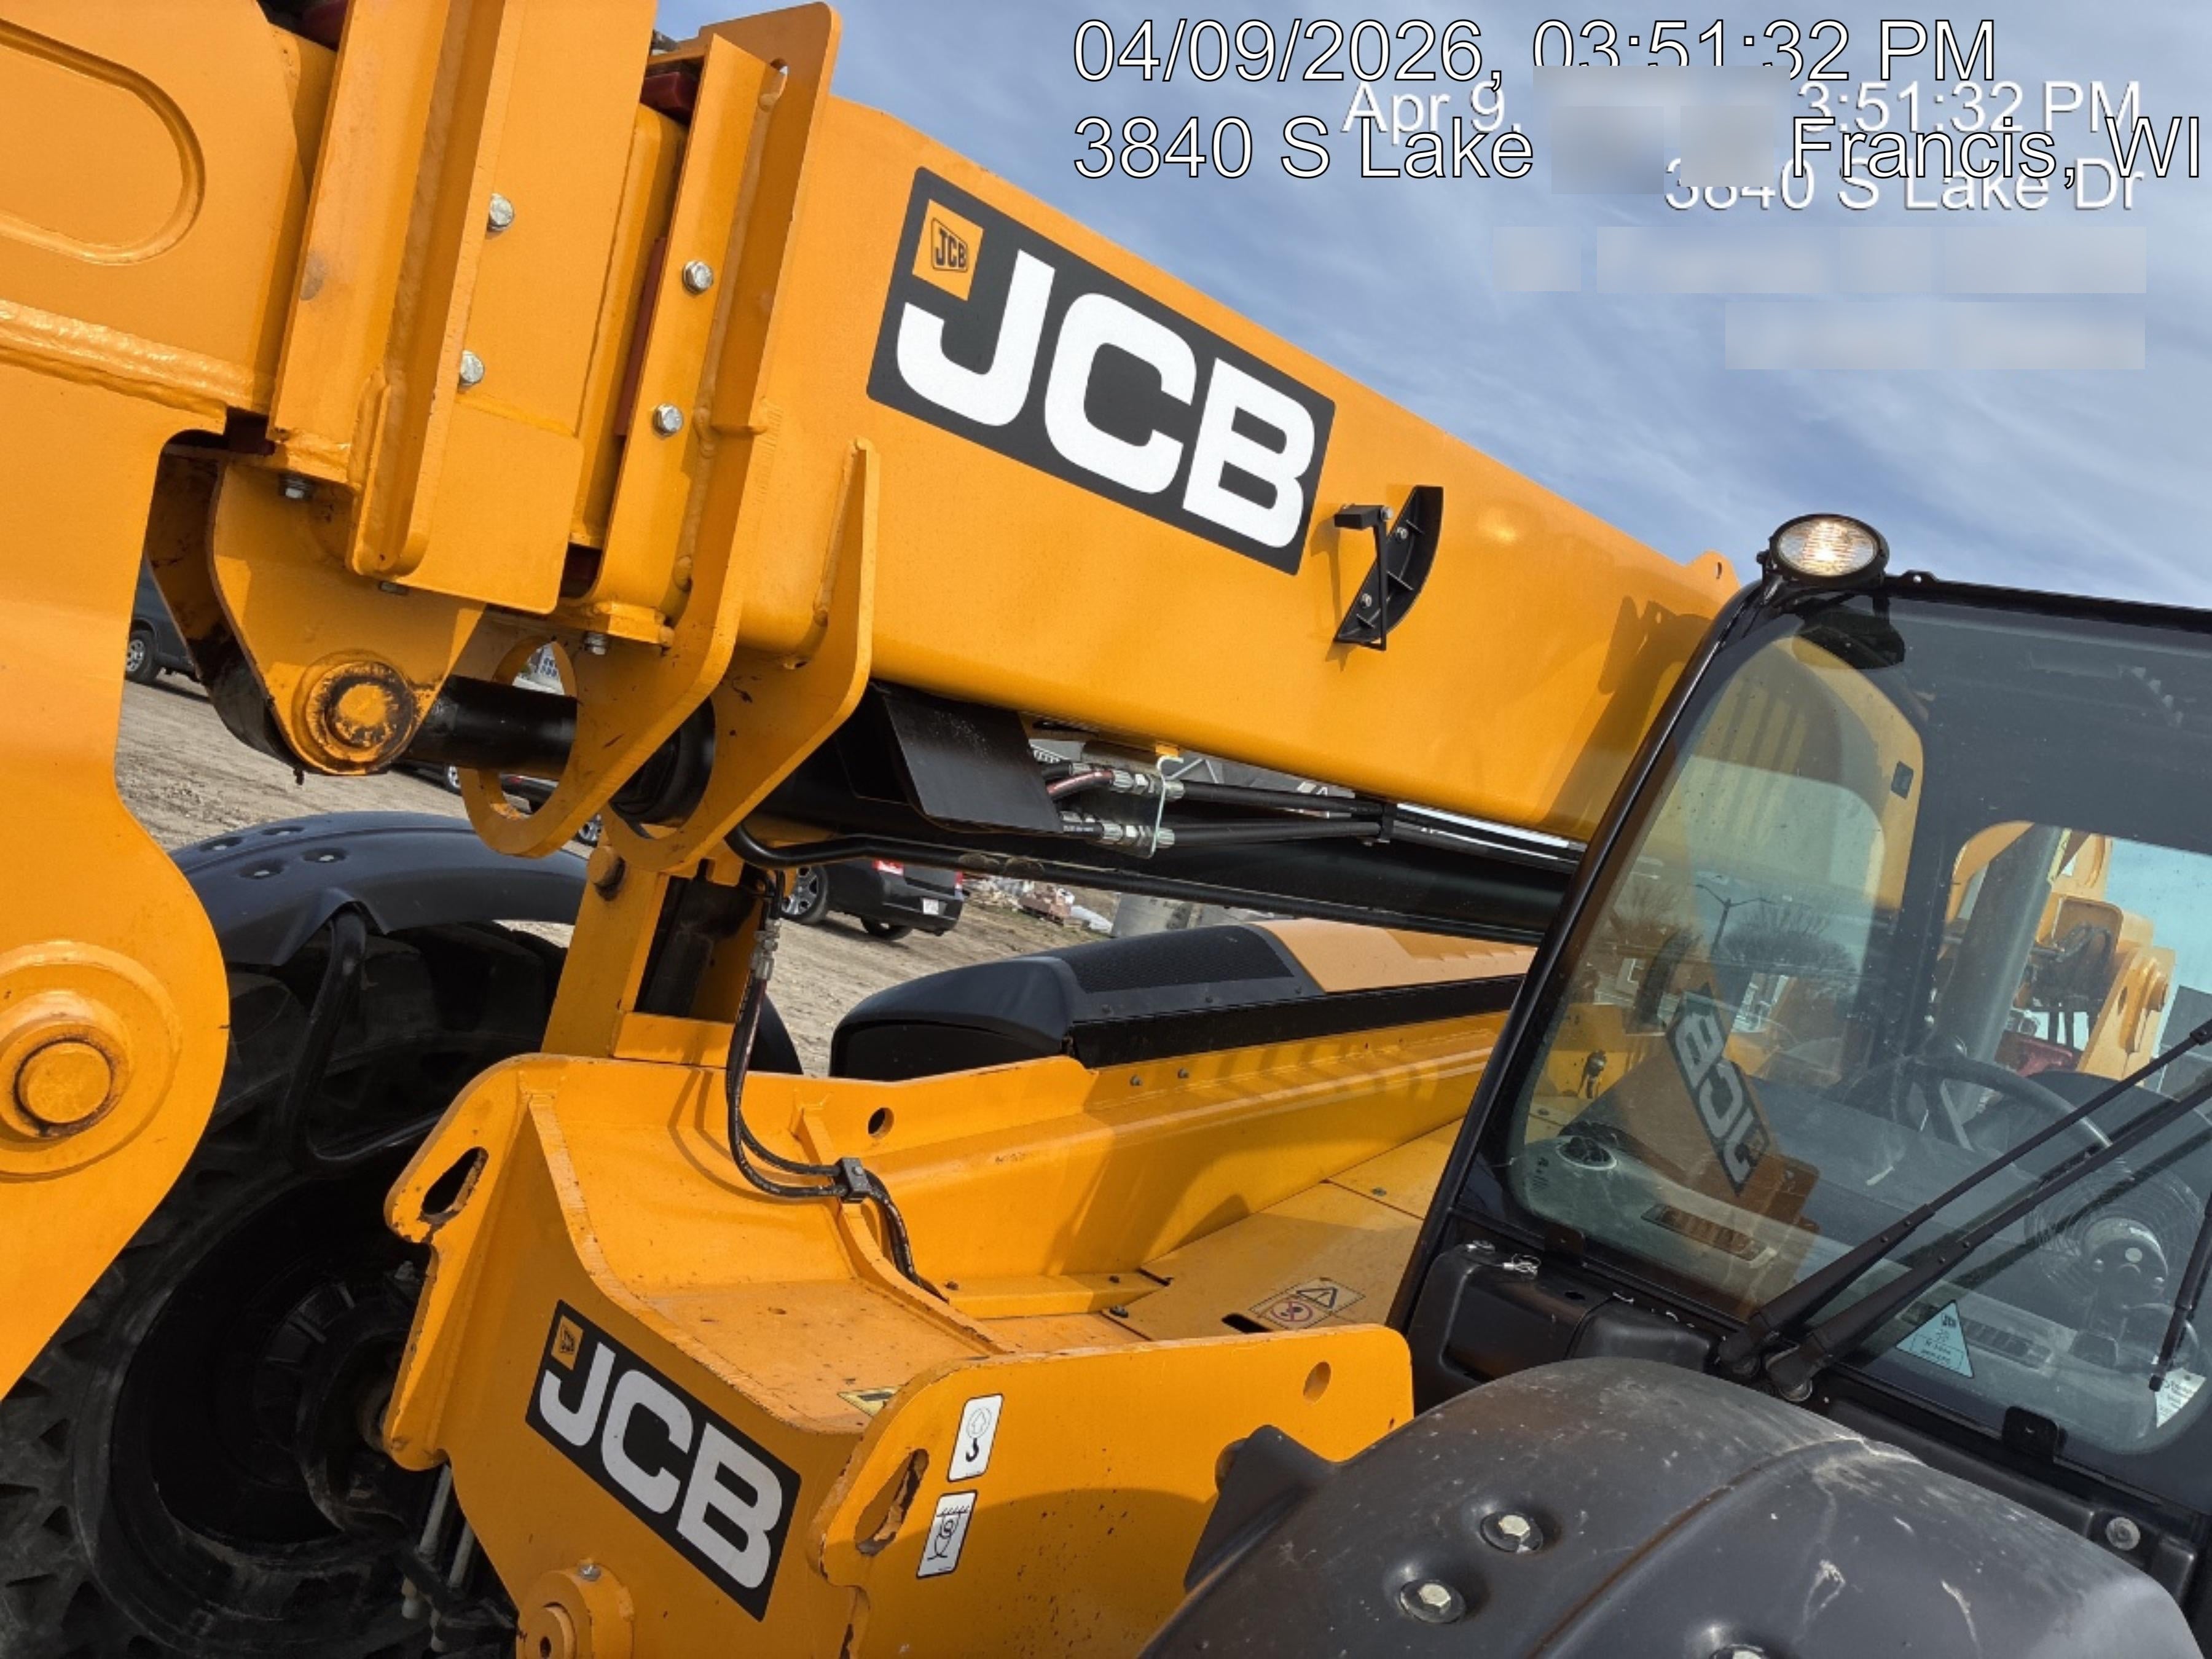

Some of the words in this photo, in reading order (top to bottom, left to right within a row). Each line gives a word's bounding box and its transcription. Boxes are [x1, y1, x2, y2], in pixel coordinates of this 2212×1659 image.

[935, 227, 967, 268] JCB
[896, 249, 1315, 548] JCB
[539, 1341, 783, 1590] JCB
